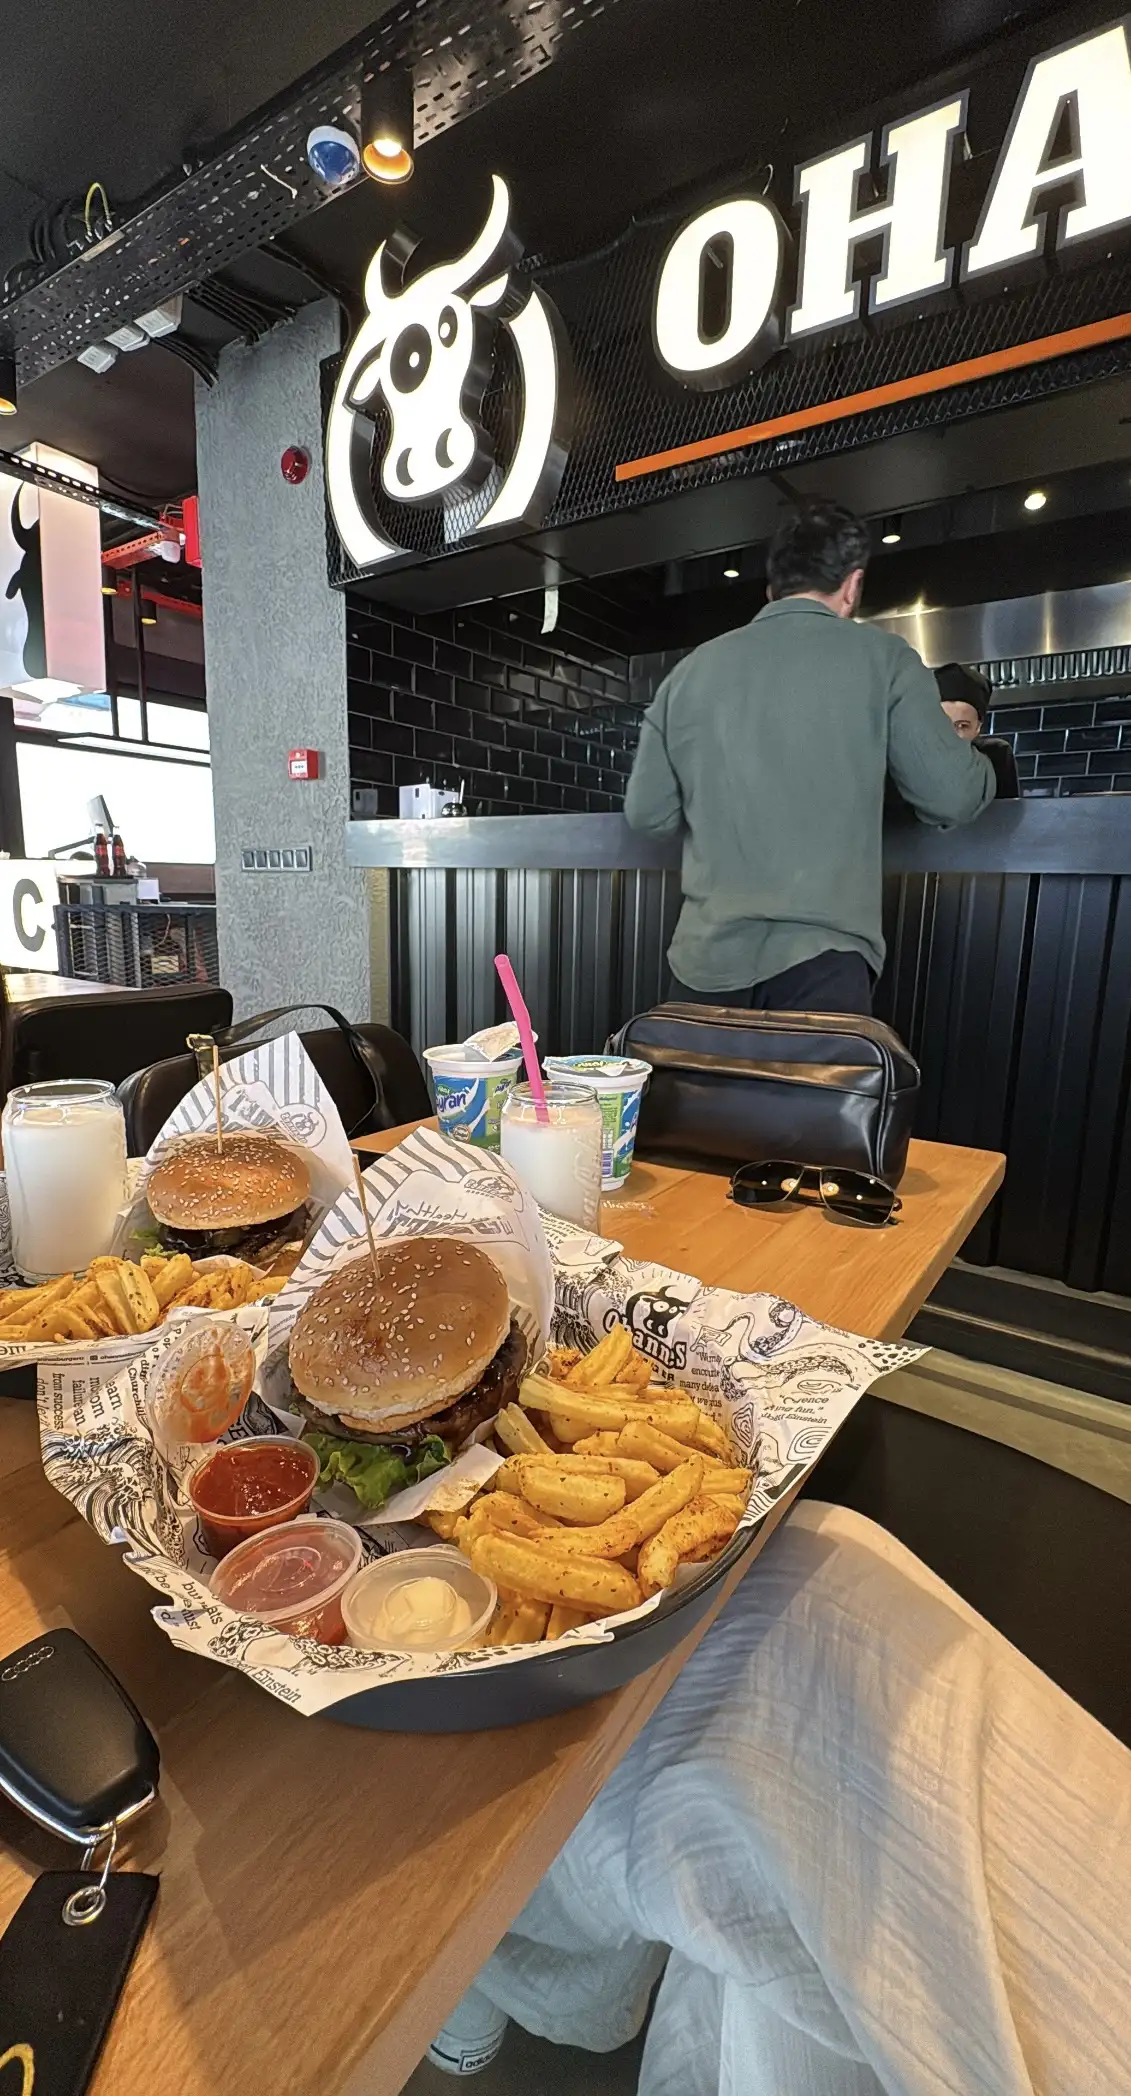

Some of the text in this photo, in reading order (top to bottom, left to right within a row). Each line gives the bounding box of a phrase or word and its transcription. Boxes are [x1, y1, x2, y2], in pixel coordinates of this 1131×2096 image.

[655, 25, 1131, 372] OHA
[13, 878, 46, 952] C
[437, 1093, 466, 1112] yran
[52, 1372, 65, 1391] from
[105, 1381, 123, 1411] earn
[252, 1668, 302, 1703] Einstein
